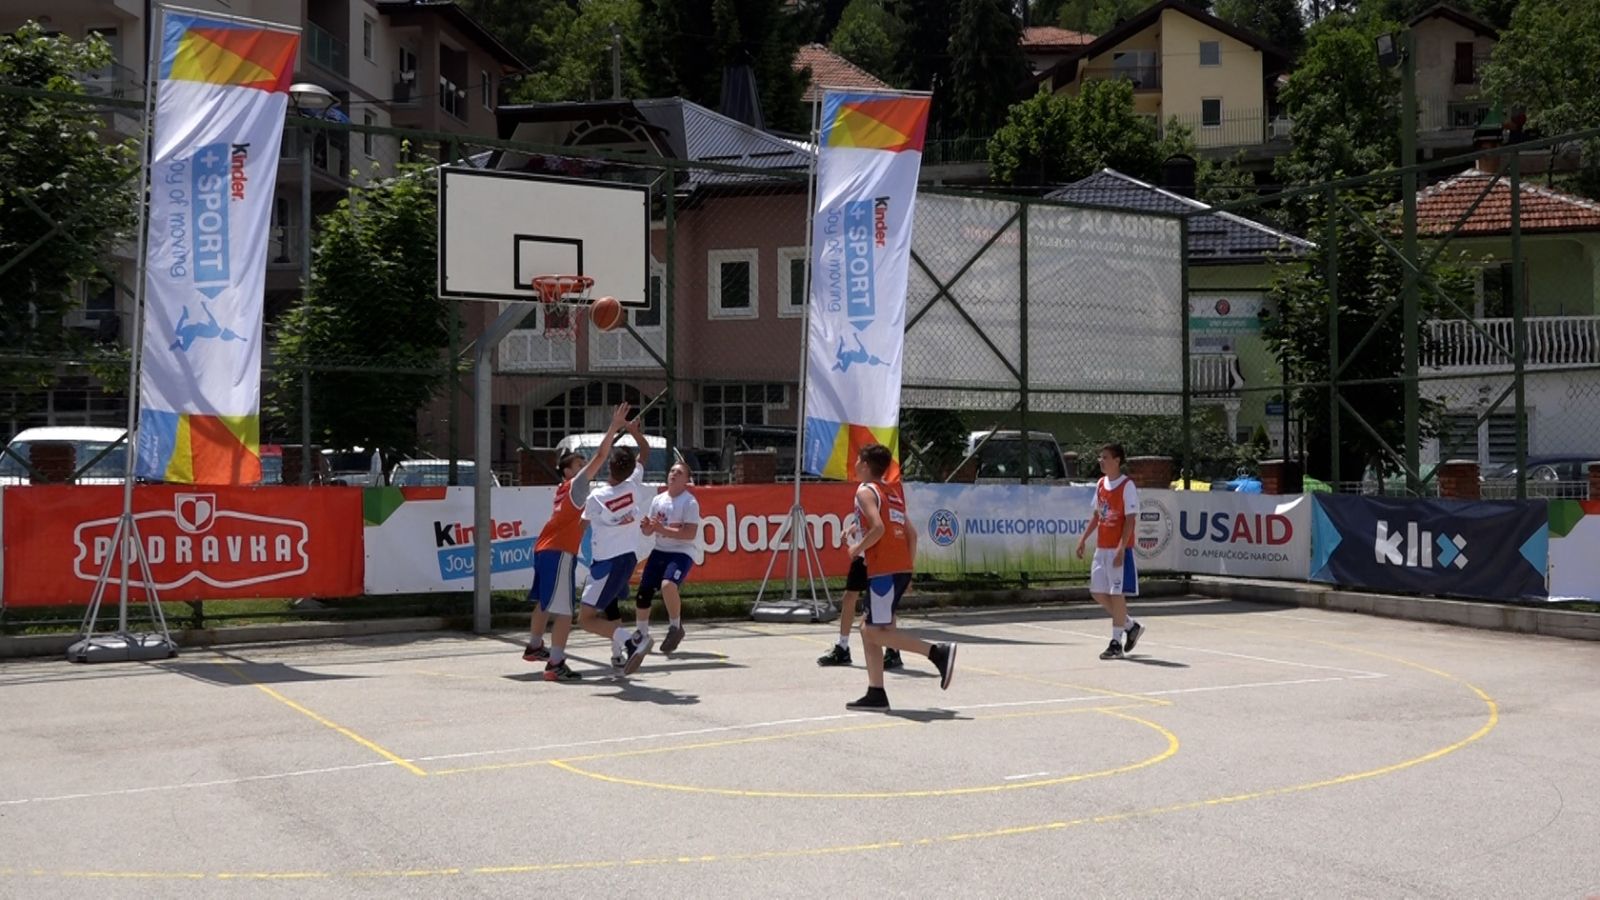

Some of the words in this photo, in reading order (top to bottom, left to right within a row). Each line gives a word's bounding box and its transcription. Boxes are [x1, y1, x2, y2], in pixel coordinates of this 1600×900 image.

[231, 143, 250, 200] Kinder
[169, 189, 189, 207] of
[875, 196, 890, 247] Kinder
[169, 212, 188, 277] moving
[828, 260, 842, 313] moving
[1180, 511, 1294, 546] USAID
[1375, 520, 1469, 570] klix
[94, 535, 292, 565] PODRAVKA
[445, 553, 475, 574] Joy
[1184, 548, 1199, 557] OD
[1201, 549, 1249, 561] AMERIČKOG
[1250, 552, 1289, 562] NARODA
